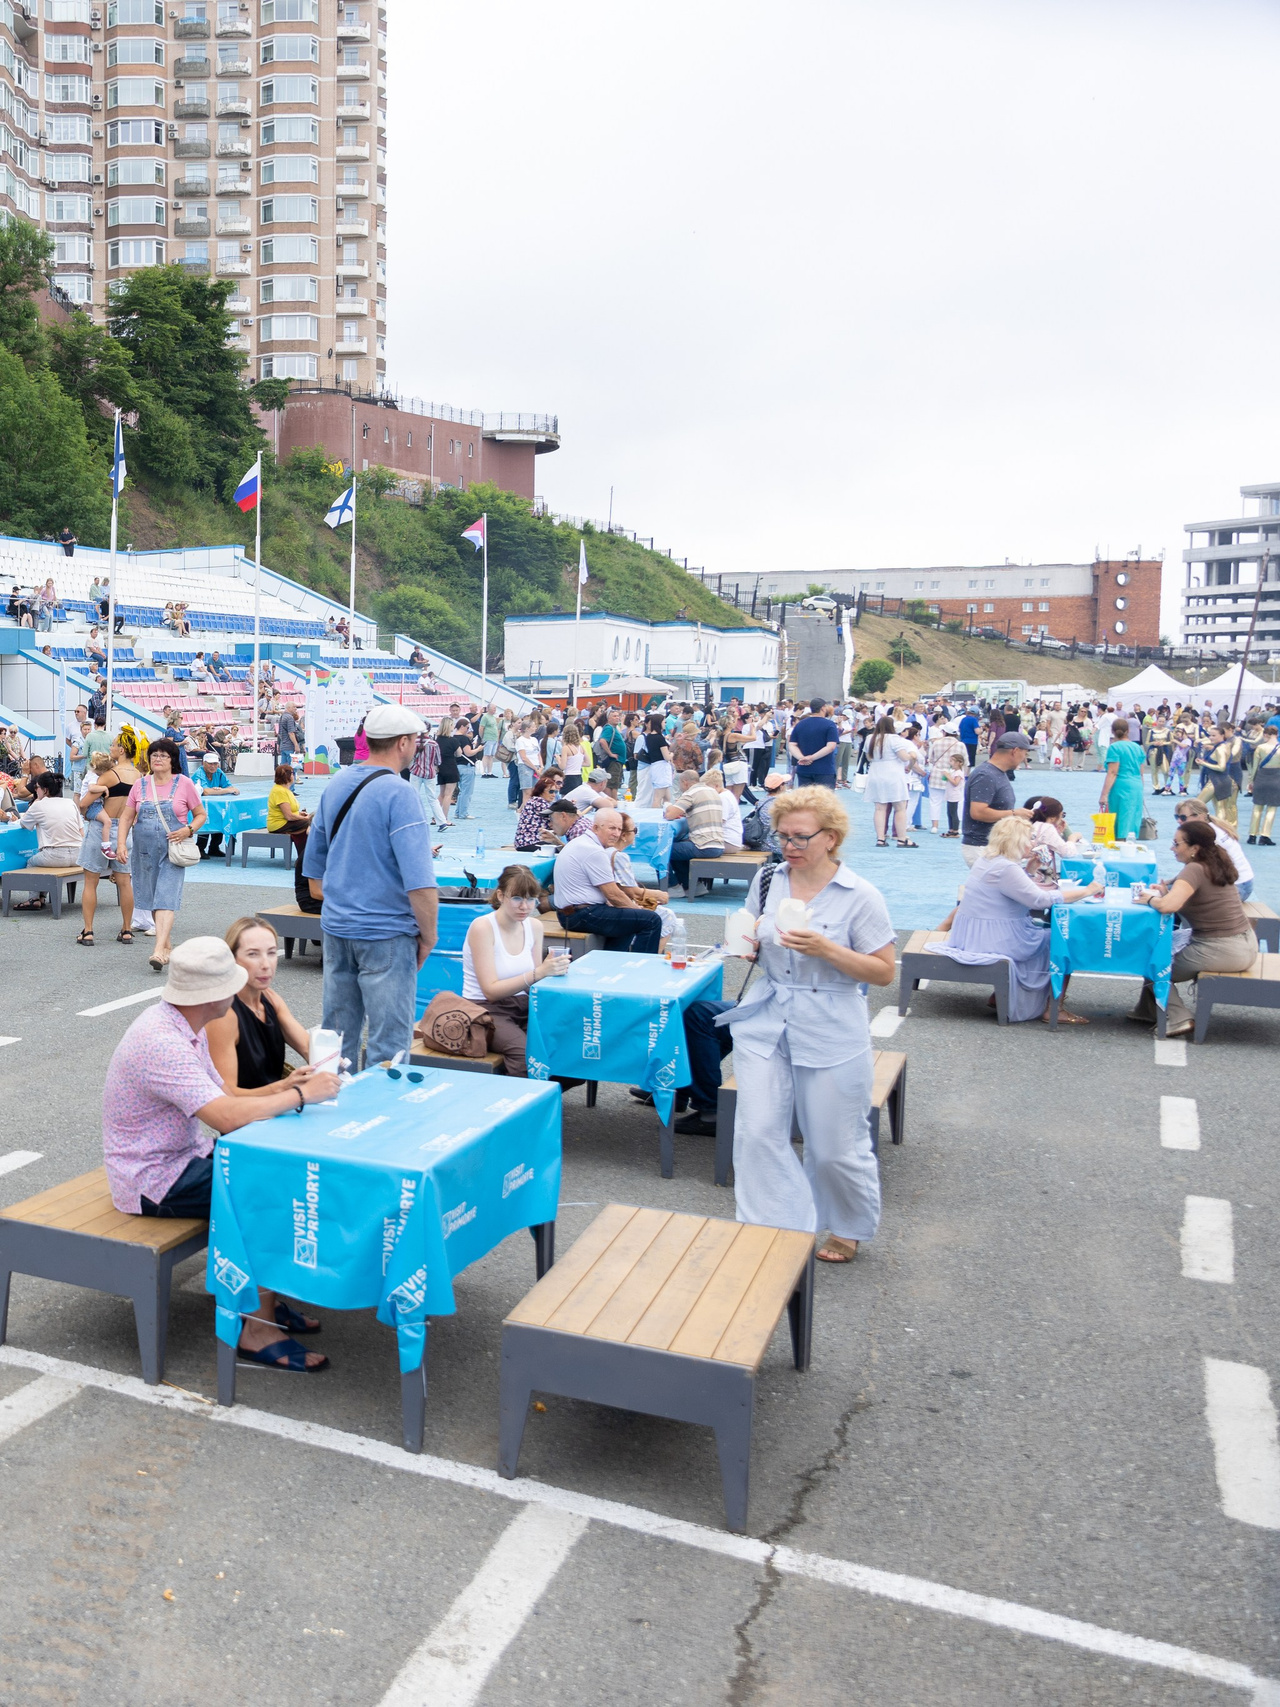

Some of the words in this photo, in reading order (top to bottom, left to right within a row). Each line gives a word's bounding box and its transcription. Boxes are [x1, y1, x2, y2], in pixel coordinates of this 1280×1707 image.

[1061, 919, 1070, 940] VISIT
[1104, 922, 1114, 959] PRIMORYE
[1113, 922, 1122, 942] VISIT
[582, 1016, 593, 1042] VISIT
[592, 992, 602, 1044] PRIMORYE
[648, 1021, 659, 1048] VISIT
[509, 1167, 535, 1191] PRIMORYE
[510, 1162, 526, 1182] VISIT
[305, 1160, 320, 1242] PRIMORYE
[449, 1201, 468, 1221] VISIT
[292, 1197, 307, 1237] VISIT
[448, 1205, 478, 1233] PRIMORYE
[382, 1216, 396, 1252] VISIT
